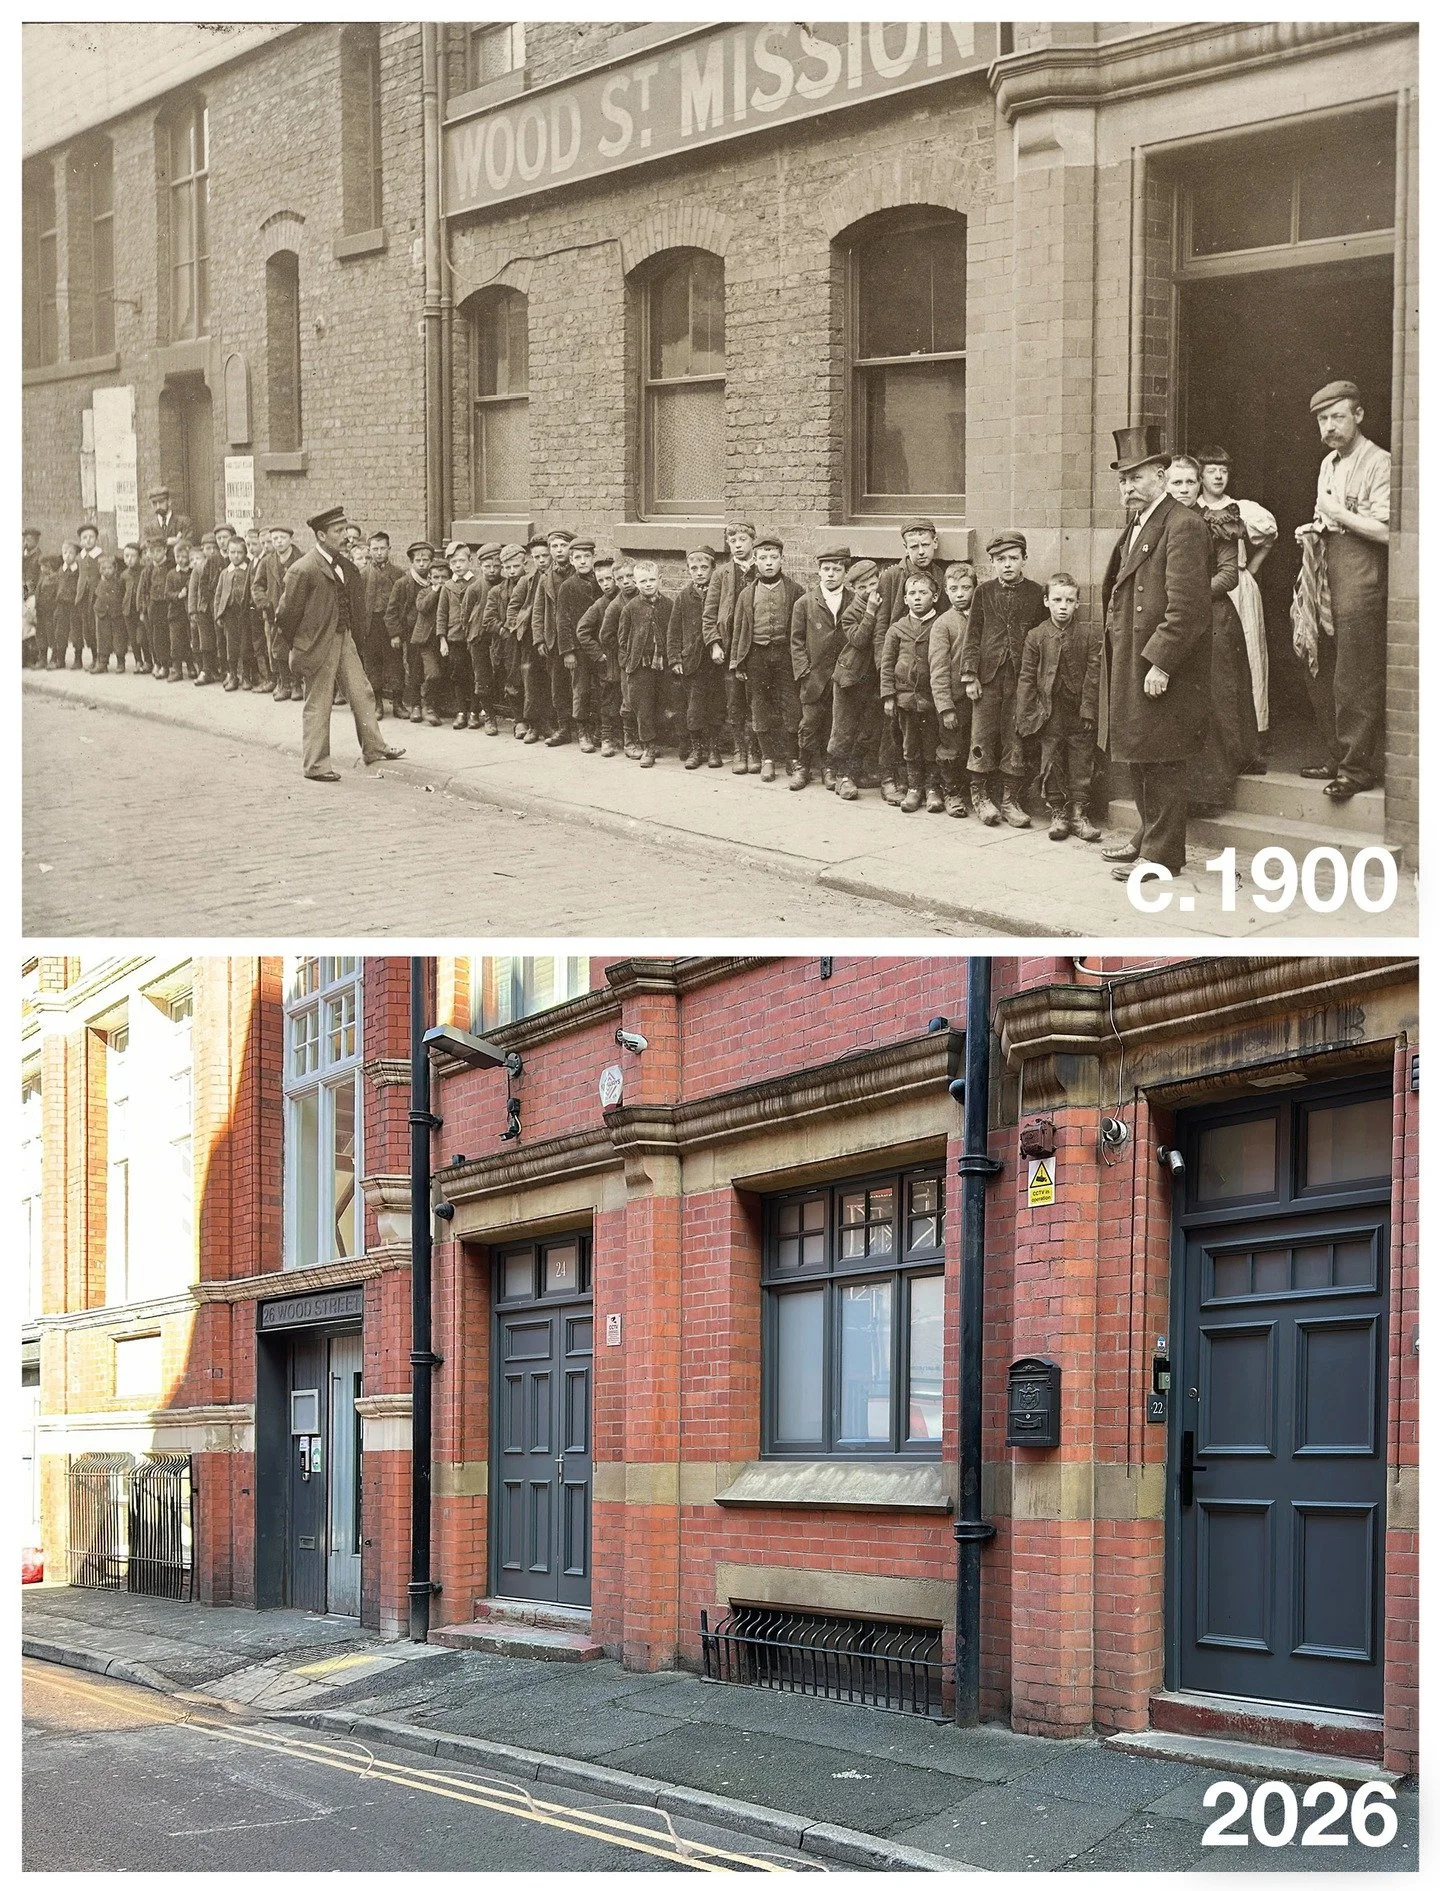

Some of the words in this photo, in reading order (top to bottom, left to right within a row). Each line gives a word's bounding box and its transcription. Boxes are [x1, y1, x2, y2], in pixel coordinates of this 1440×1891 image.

[452, 97, 582, 200] WOOD
[555, 1261, 566, 1277] 24
[263, 1308, 275, 1322] 26
[277, 1302, 312, 1319] WOOD
[315, 1295, 360, 1316] STREET
[1152, 1401, 1164, 1414] 22
